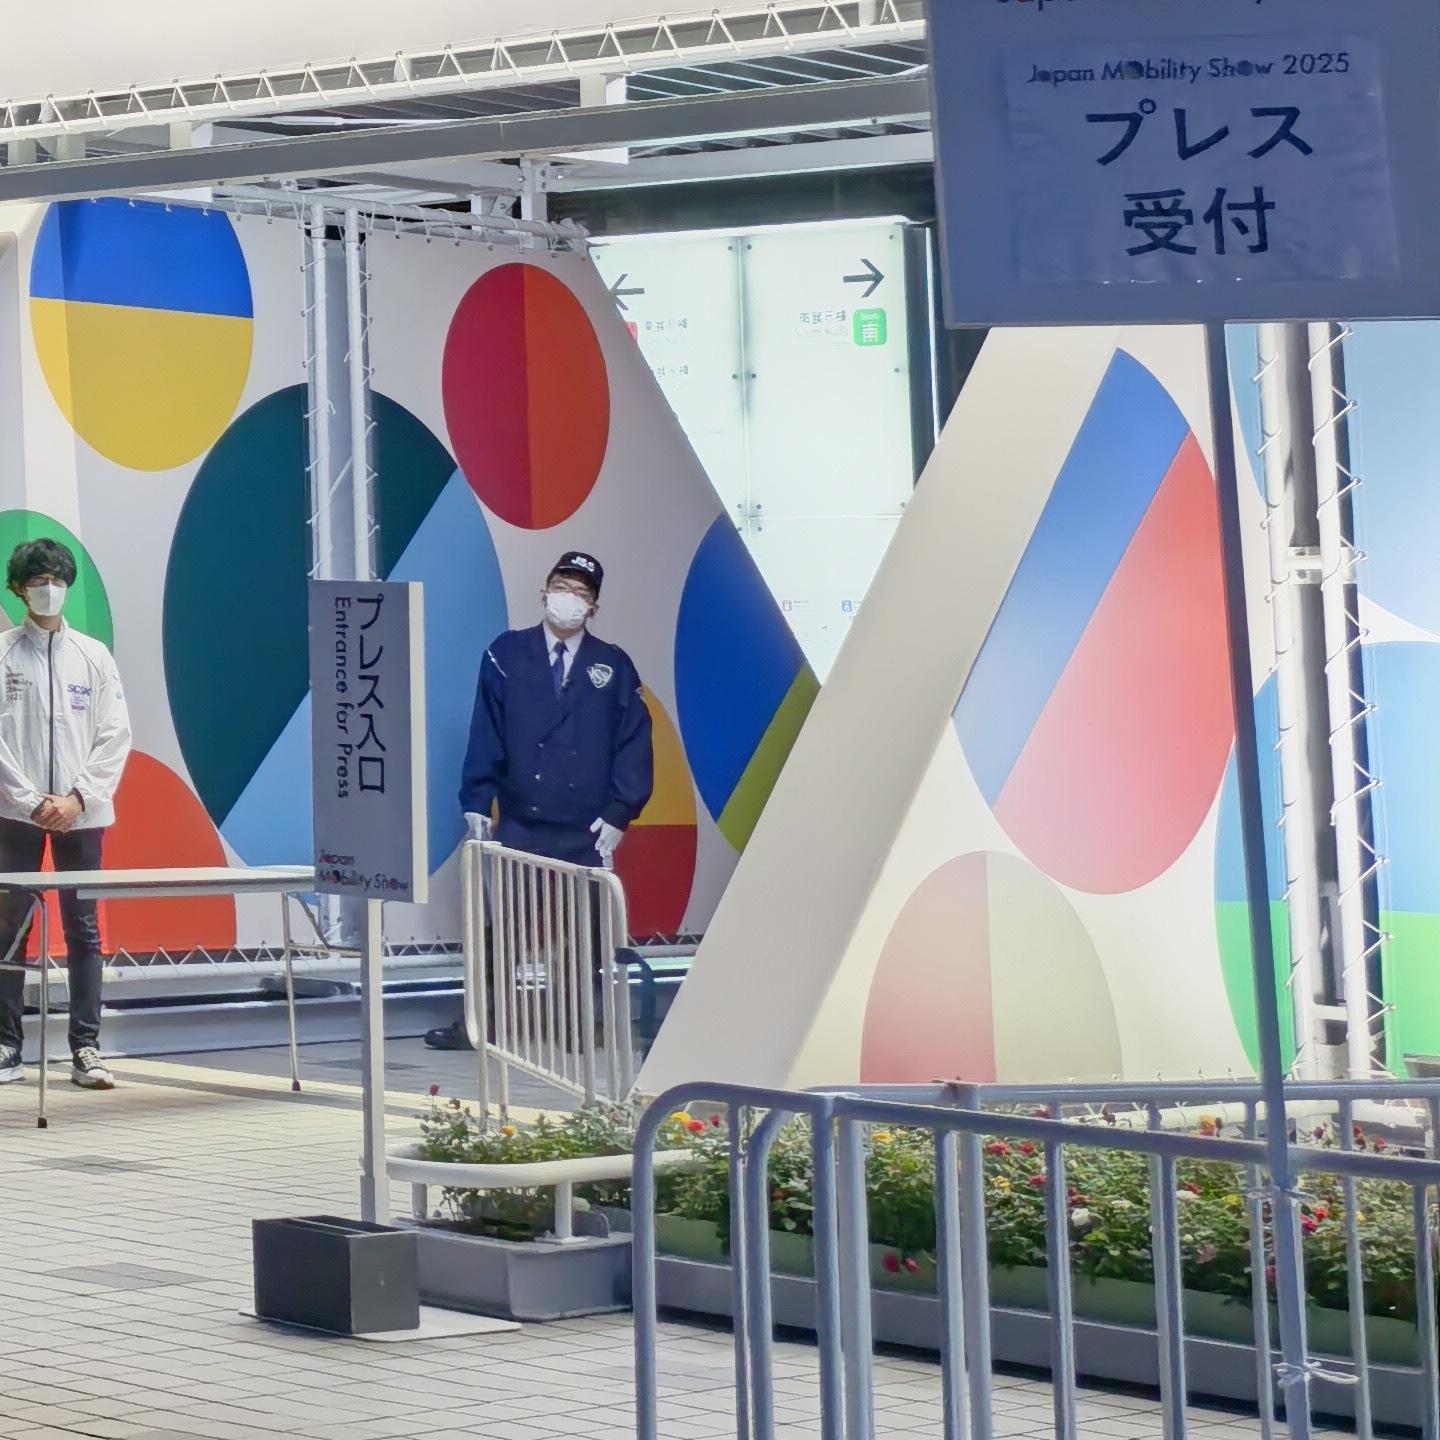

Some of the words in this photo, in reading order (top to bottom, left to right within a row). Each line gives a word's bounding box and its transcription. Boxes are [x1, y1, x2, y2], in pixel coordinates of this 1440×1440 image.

[1026, 64, 1094, 87] Japan
[1101, 59, 1201, 84] Mobility
[1207, 57, 1272, 78] Show
[1283, 52, 1350, 75] 2025
[1085, 98, 1314, 166] プレス
[1122, 186, 1276, 257] 受付
[334, 596, 351, 694] Entrance
[336, 701, 354, 739] for
[356, 593, 386, 795] プレス入口
[337, 743, 353, 799] Press
